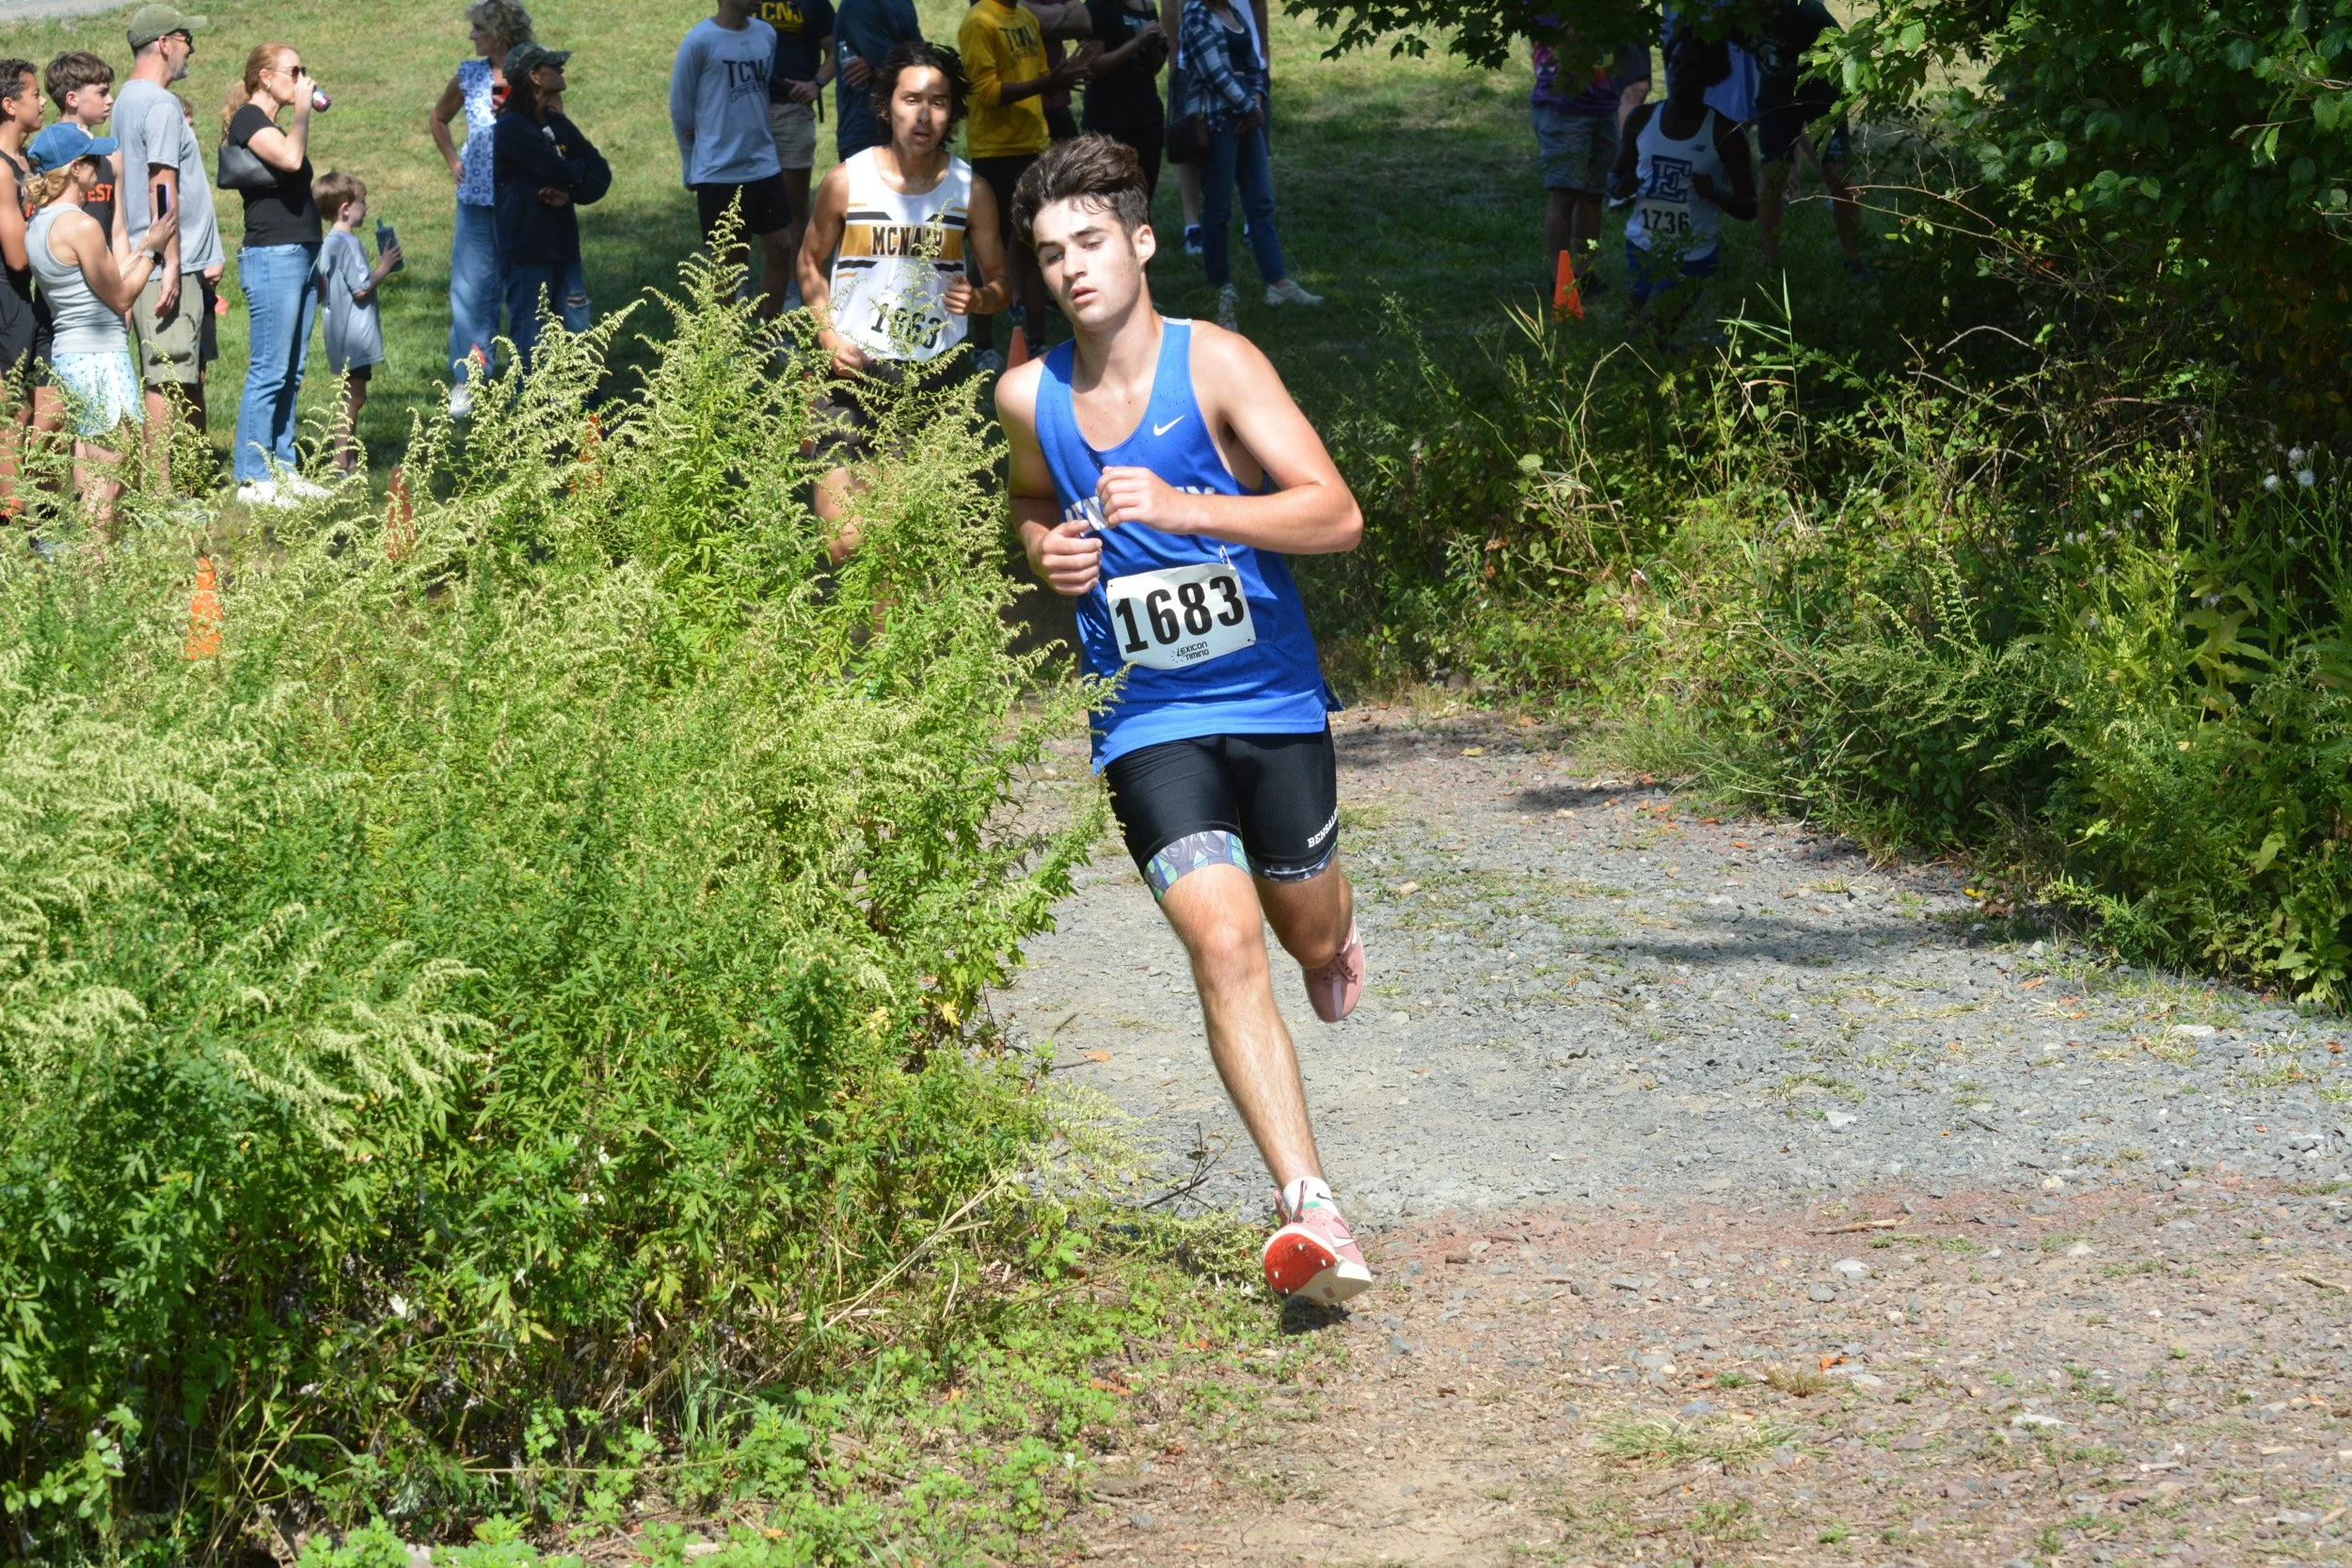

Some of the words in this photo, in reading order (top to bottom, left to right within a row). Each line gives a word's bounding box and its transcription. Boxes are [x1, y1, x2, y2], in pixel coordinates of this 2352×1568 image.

[752, 2, 804, 24] CNJ
[1645, 154, 1693, 204] E
[81, 183, 113, 202] EST
[1642, 208, 1690, 234] 1736
[1115, 576, 1245, 654] 1683
[1176, 641, 1208, 657] LEXICON
